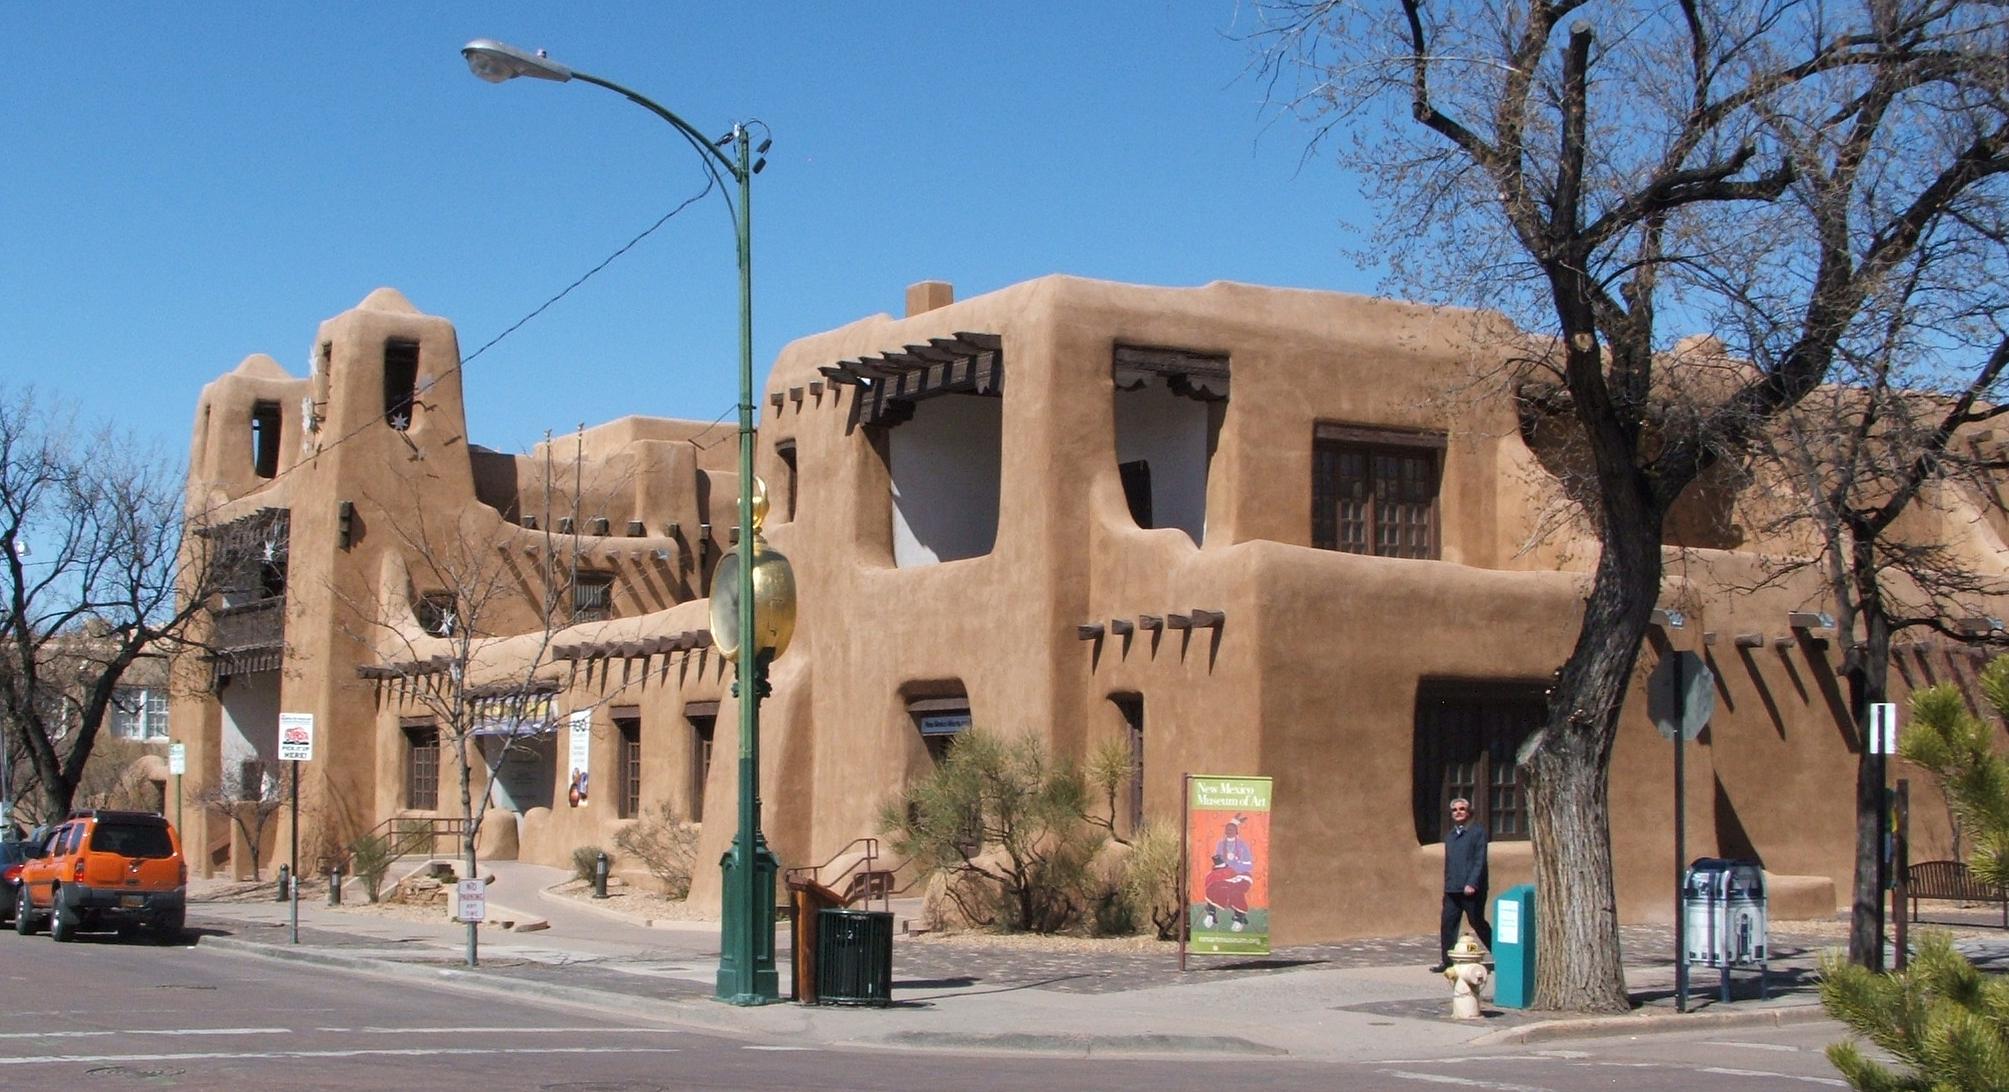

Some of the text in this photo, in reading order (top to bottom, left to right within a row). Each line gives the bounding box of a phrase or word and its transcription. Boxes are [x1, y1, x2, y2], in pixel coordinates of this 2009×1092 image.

[1198, 782, 1255, 794] New Mexico
[1198, 794, 1266, 807] Museum of Art
